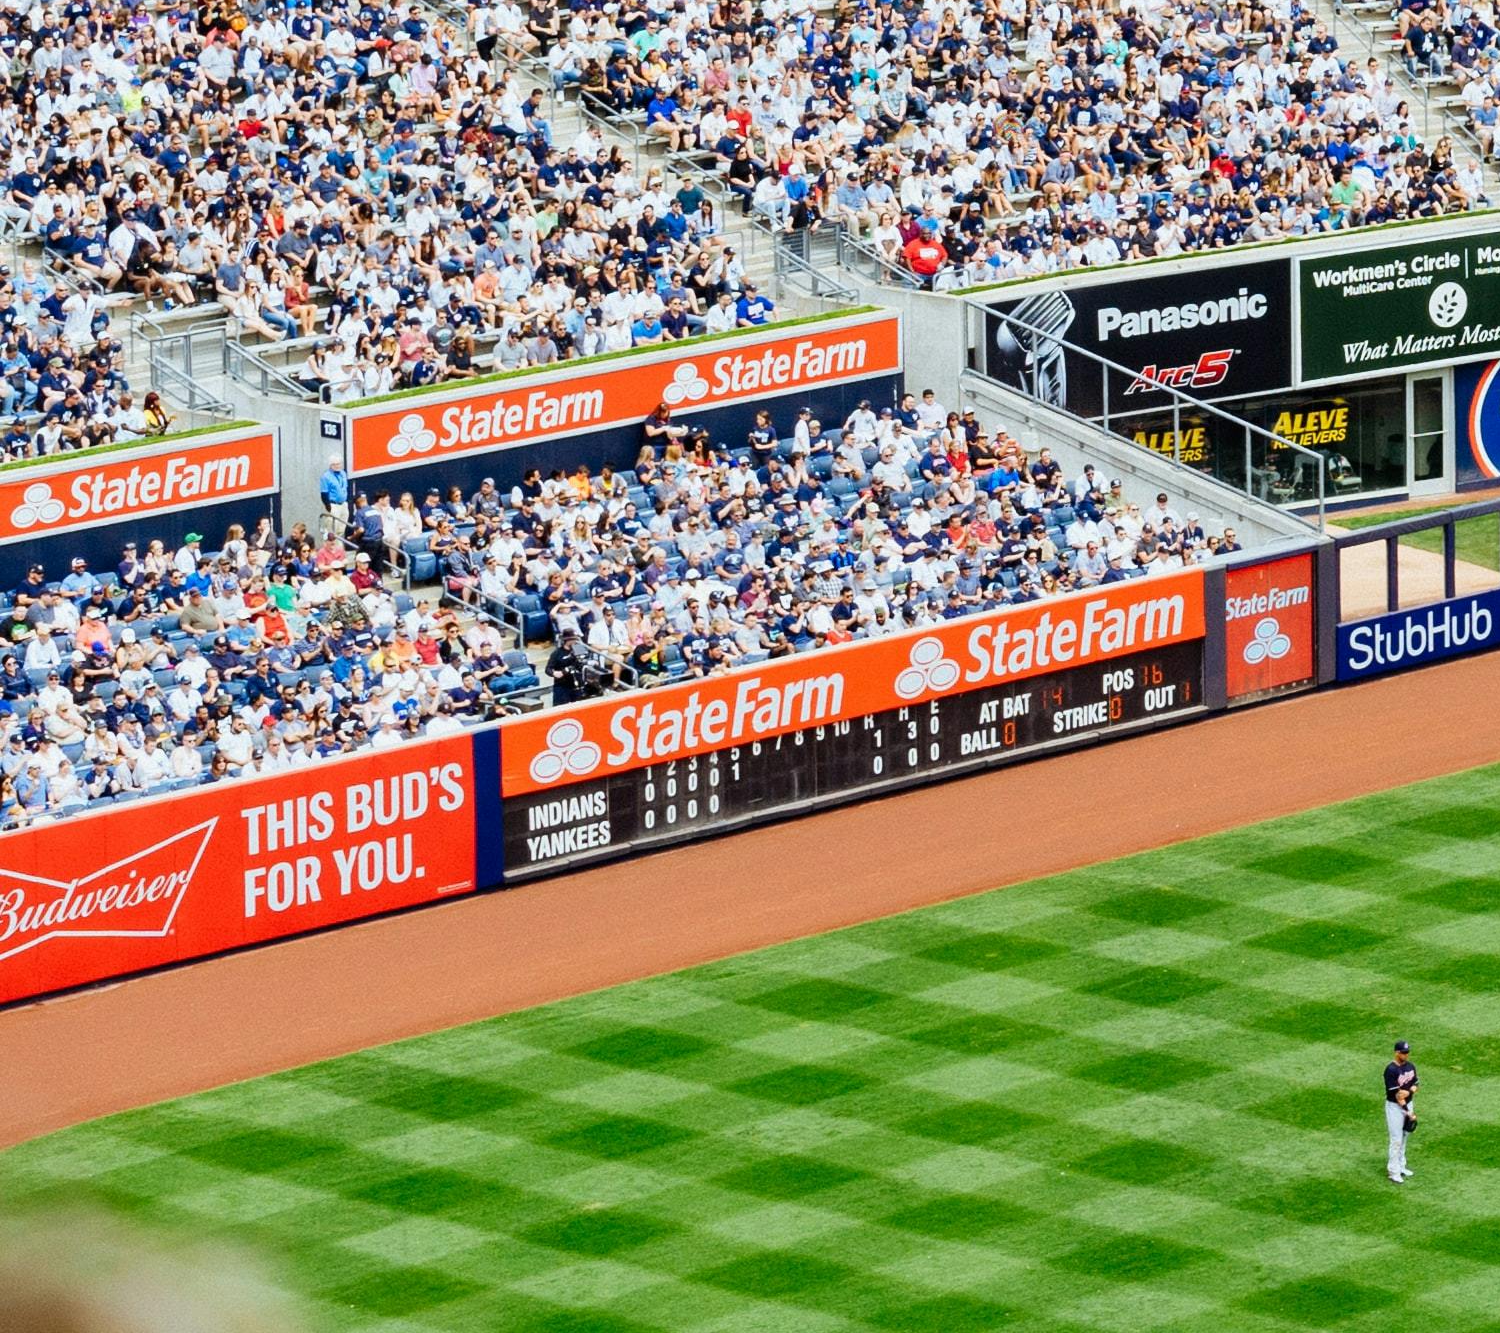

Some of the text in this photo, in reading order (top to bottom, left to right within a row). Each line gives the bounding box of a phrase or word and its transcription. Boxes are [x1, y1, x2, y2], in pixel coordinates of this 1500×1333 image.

[1411, 252, 1460, 273] Circle
[1098, 288, 1268, 342] Panasonic
[1349, 599, 1491, 671] StubHub
[241, 790, 333, 856] THIS
[529, 792, 607, 832] INDIANS
[528, 820, 611, 862] YANKEES
[244, 833, 425, 919] FOR YOU.
